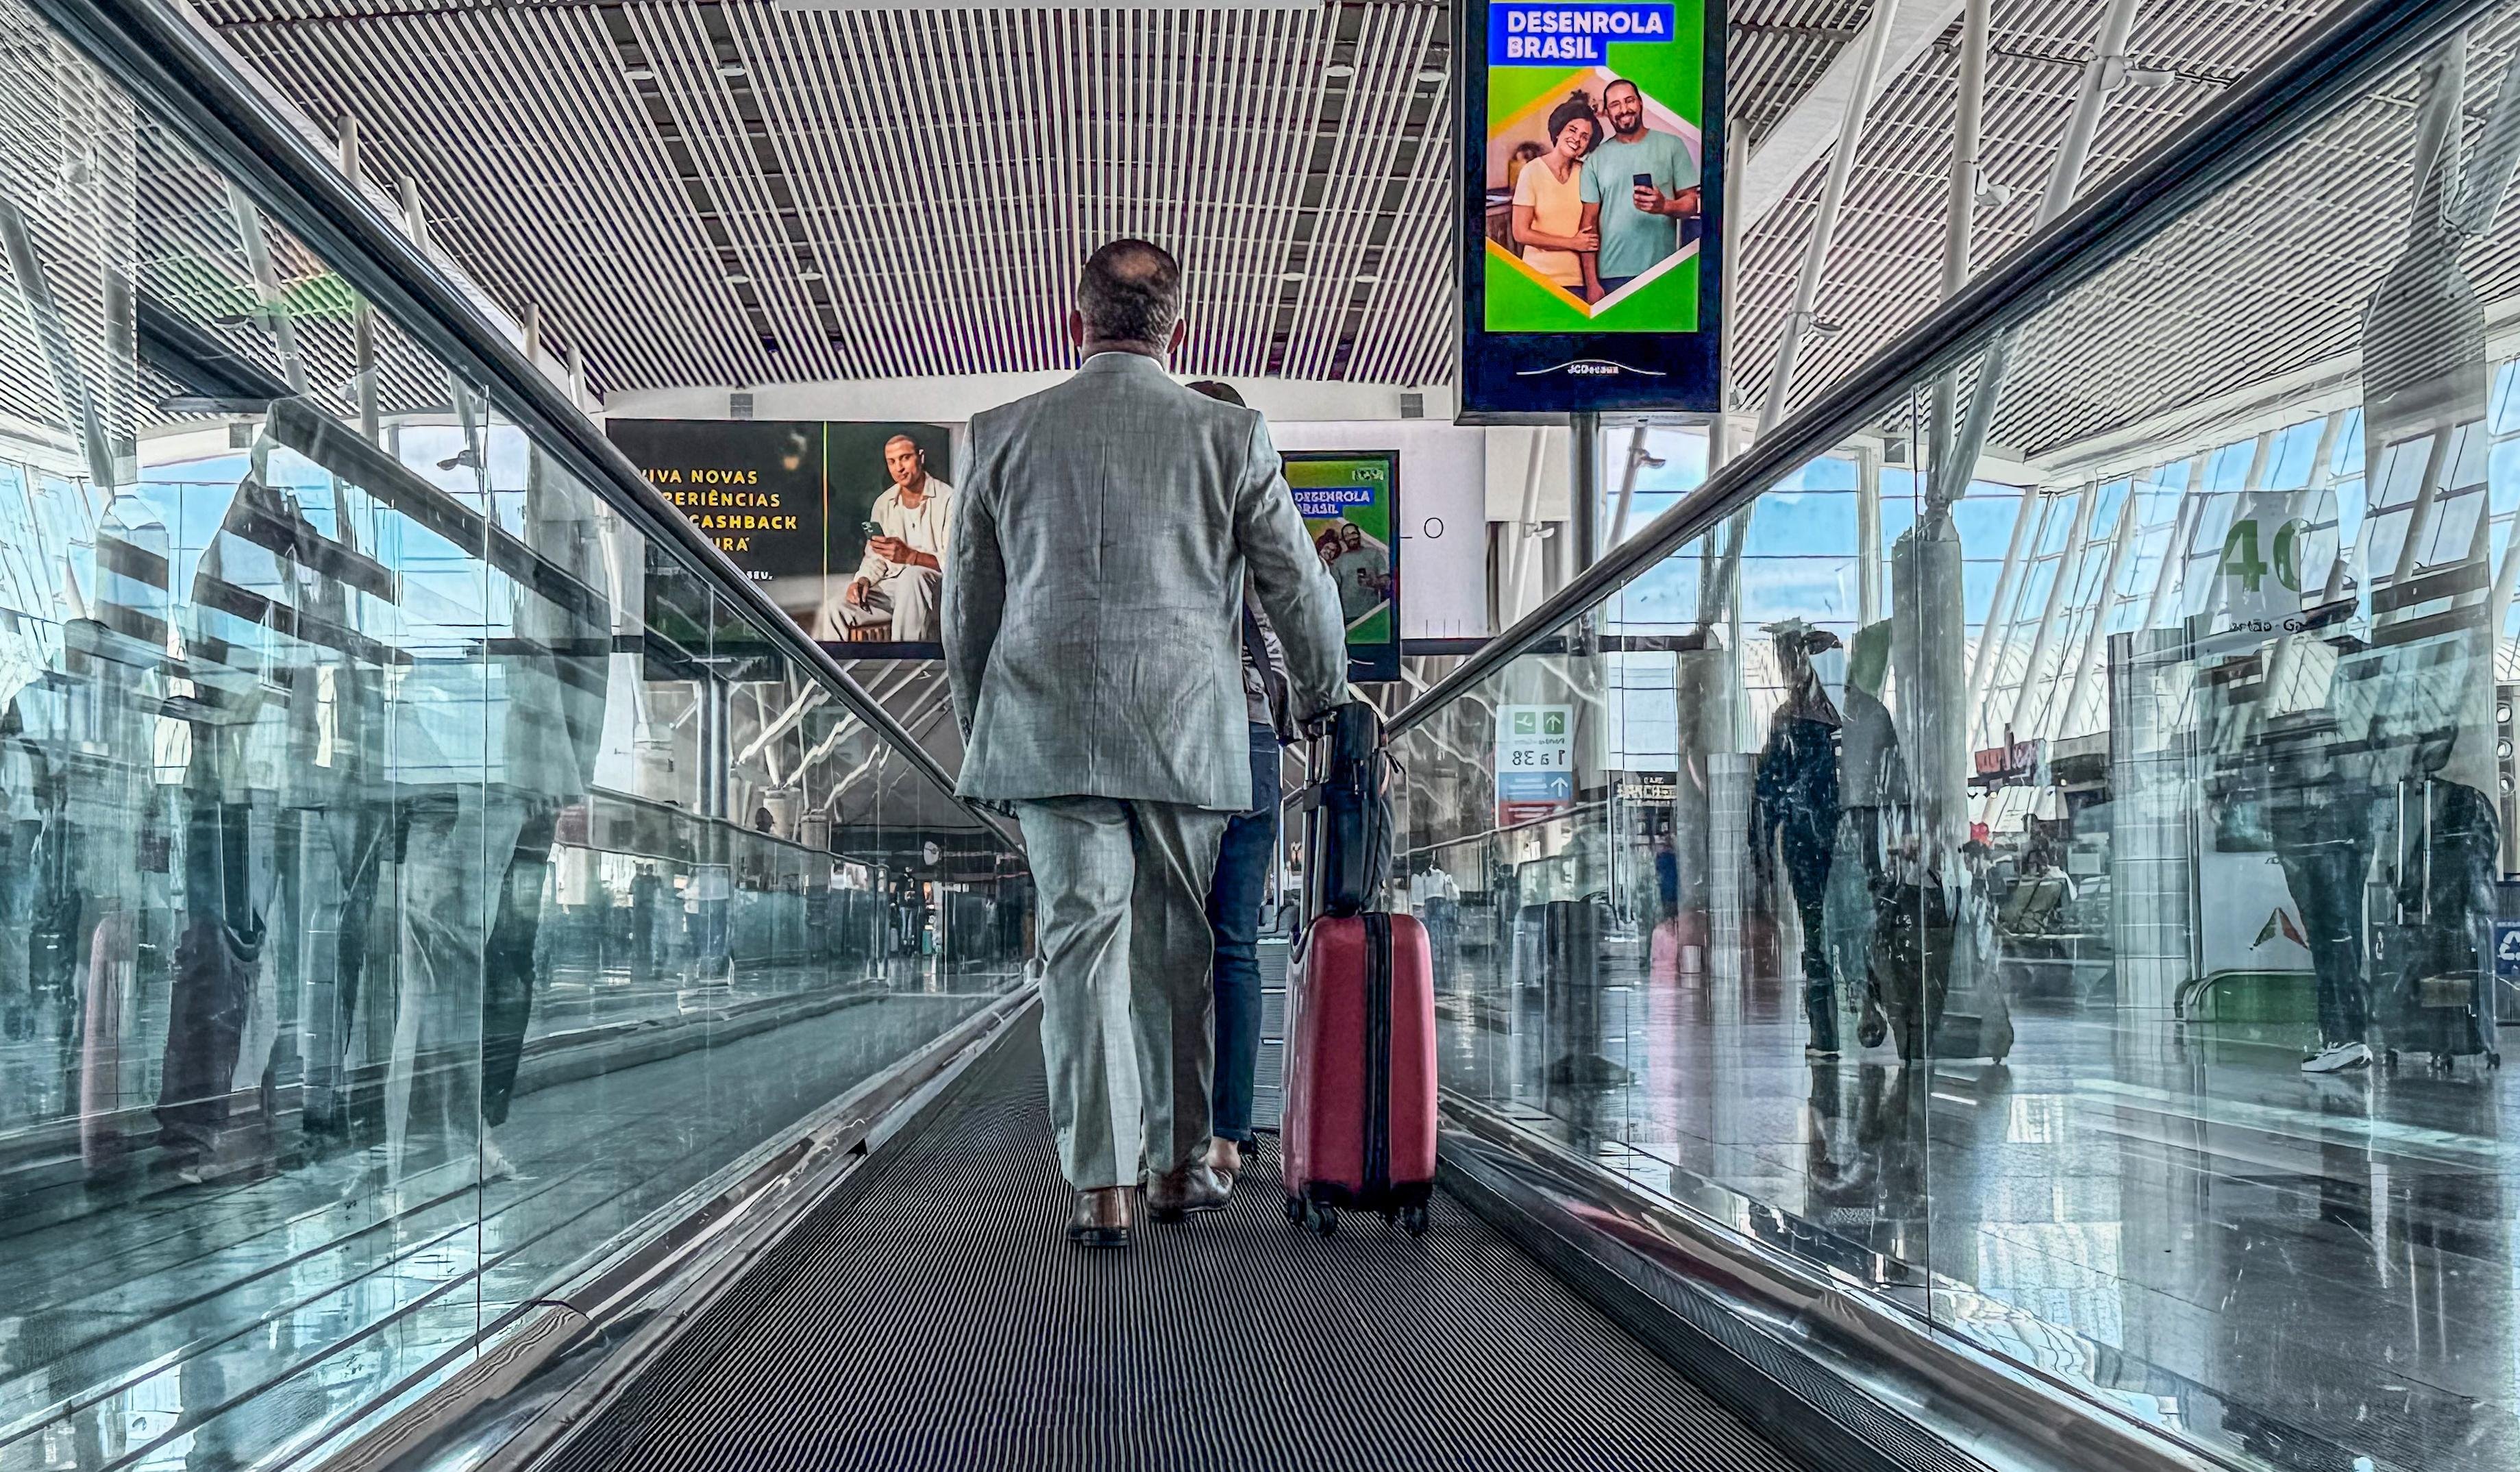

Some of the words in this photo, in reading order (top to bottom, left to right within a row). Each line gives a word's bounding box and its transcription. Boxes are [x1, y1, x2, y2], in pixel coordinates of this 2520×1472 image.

[1507, 10, 1664, 34] DESENROLA
[1507, 36, 1598, 59] BRASIL
[691, 469, 758, 484] NOVAS
[663, 489, 780, 507] PERIÊNCIAS
[1294, 490, 1370, 503] DESENROLA
[689, 514, 798, 530] CASHBACK
